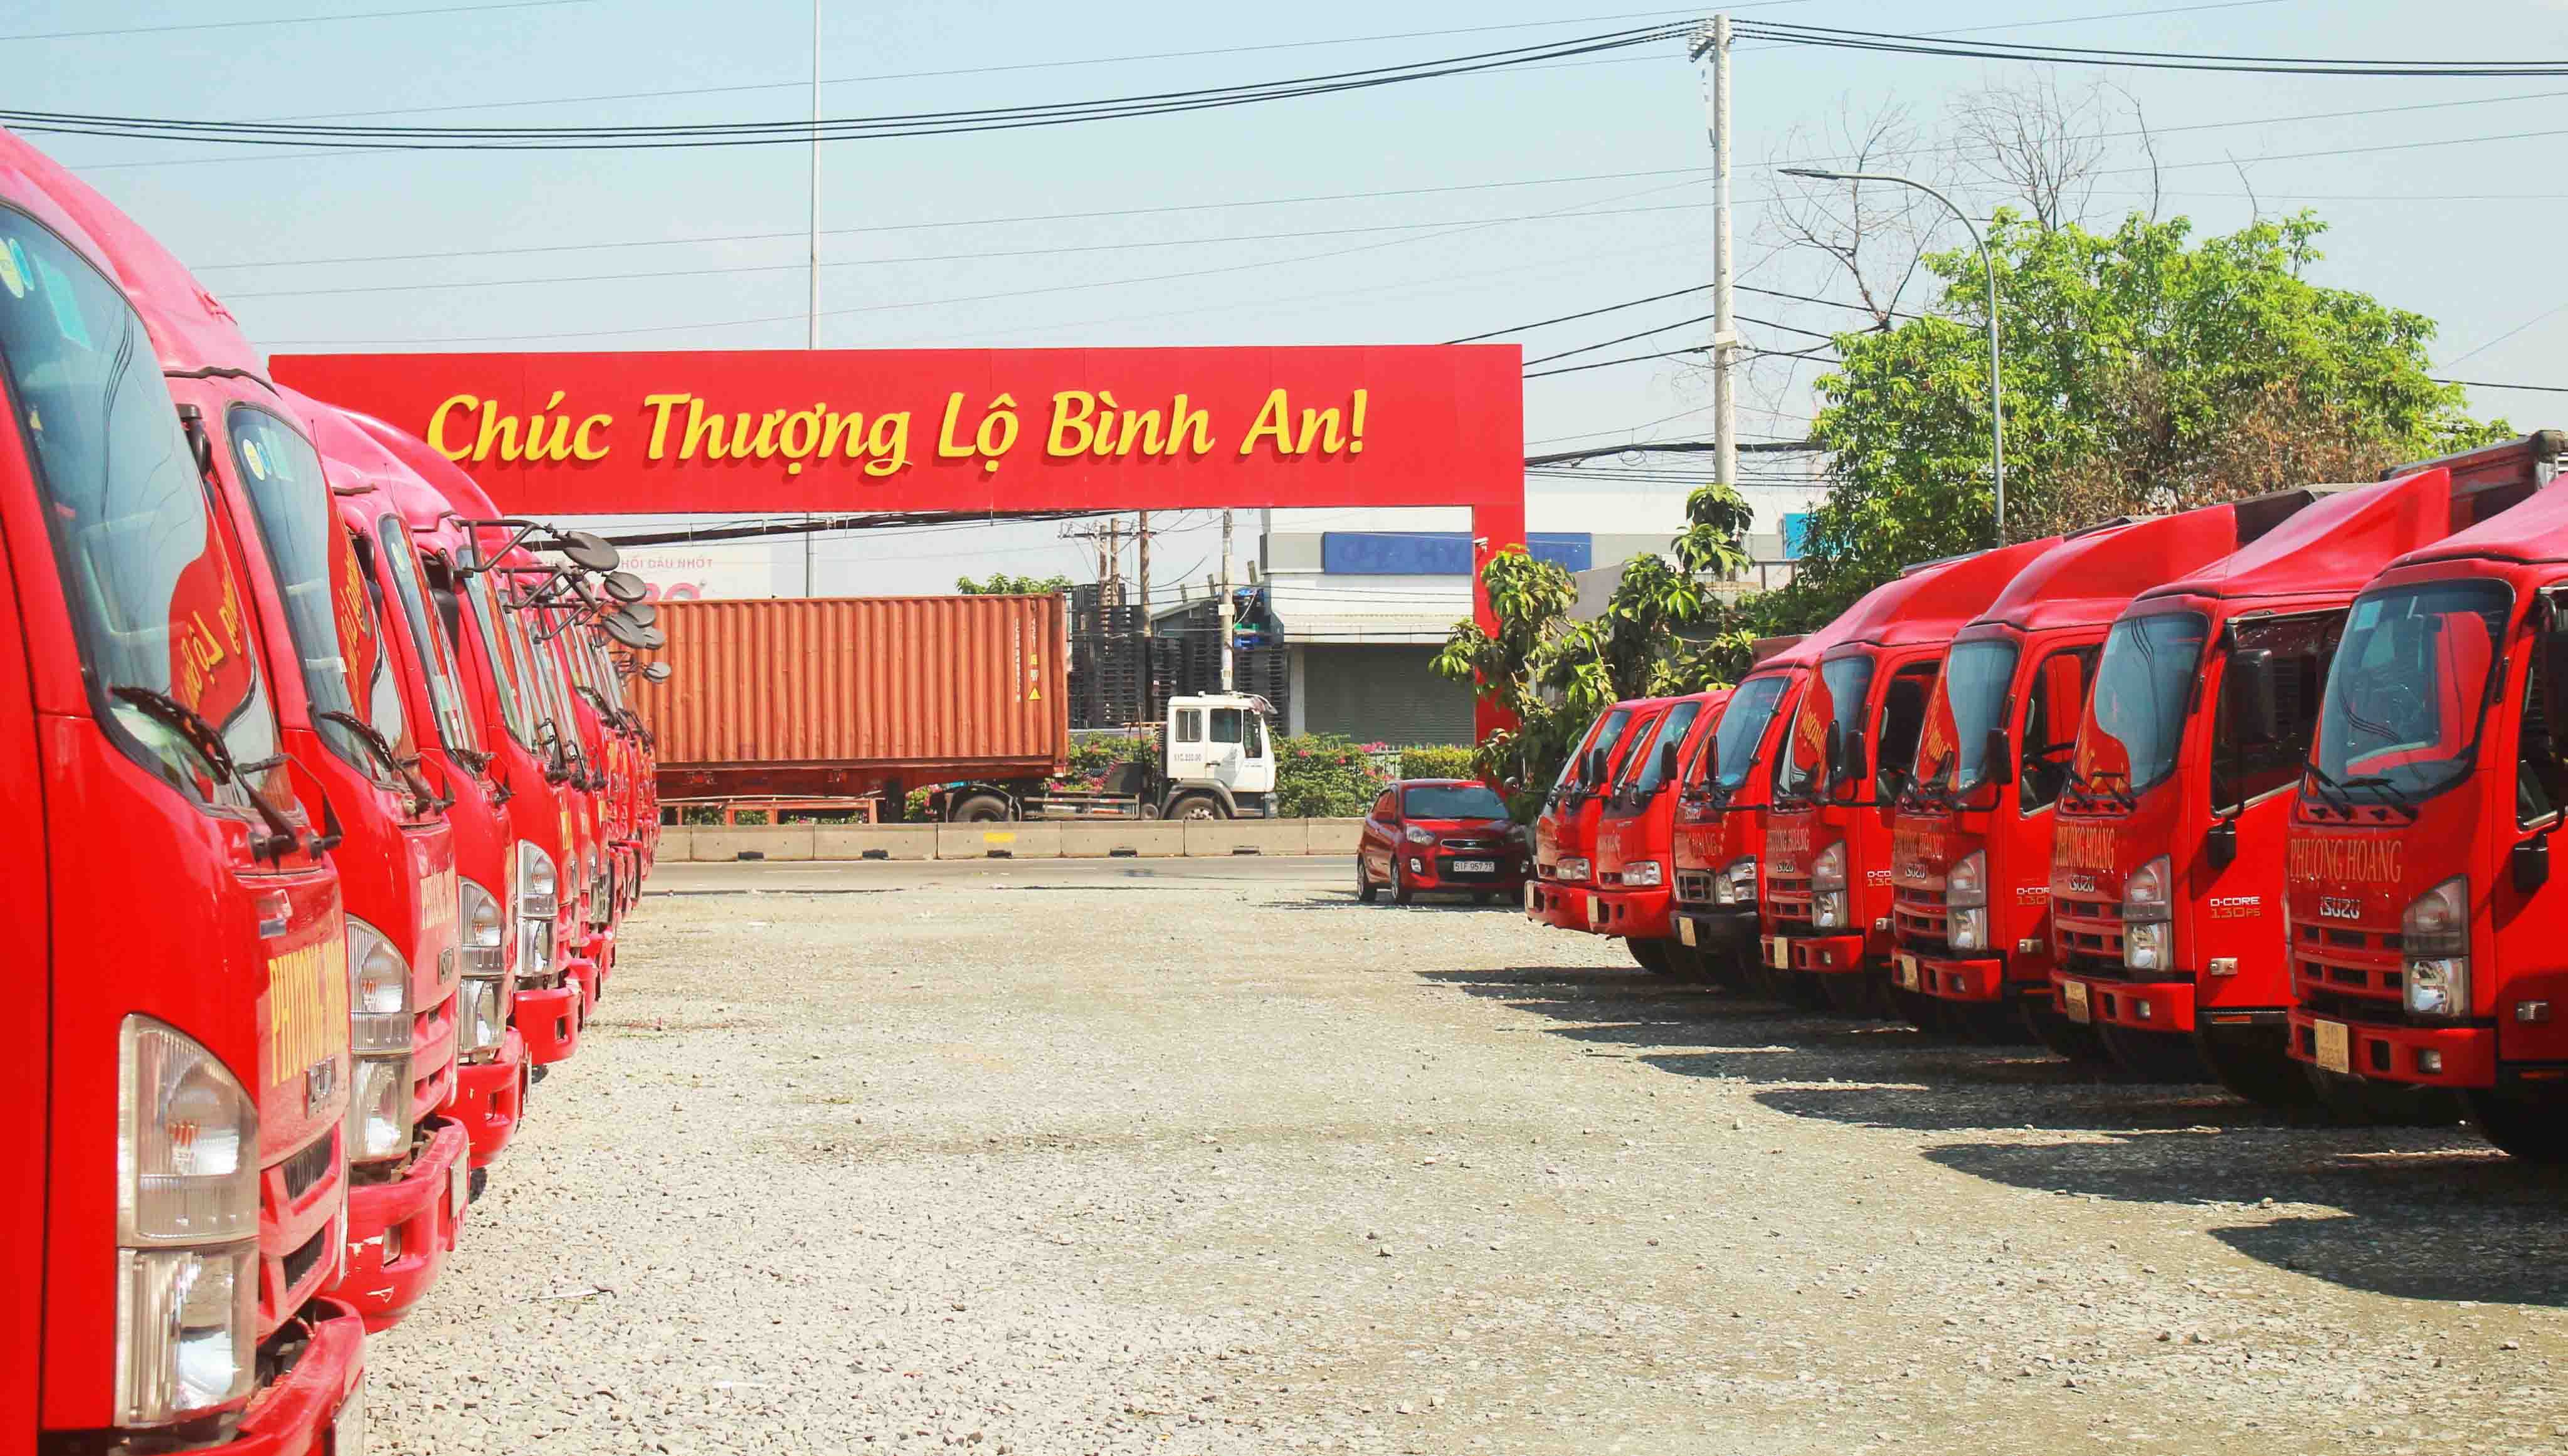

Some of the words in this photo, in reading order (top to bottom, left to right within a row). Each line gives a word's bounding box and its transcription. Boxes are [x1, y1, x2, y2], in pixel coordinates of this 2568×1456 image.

[428, 391, 612, 460] Chúc
[643, 394, 912, 477] Thượng
[939, 393, 1018, 472] Lộ
[1049, 391, 1213, 456] Bình
[1240, 389, 1366, 454] An!
[2320, 896, 2361, 920] ISUZU
